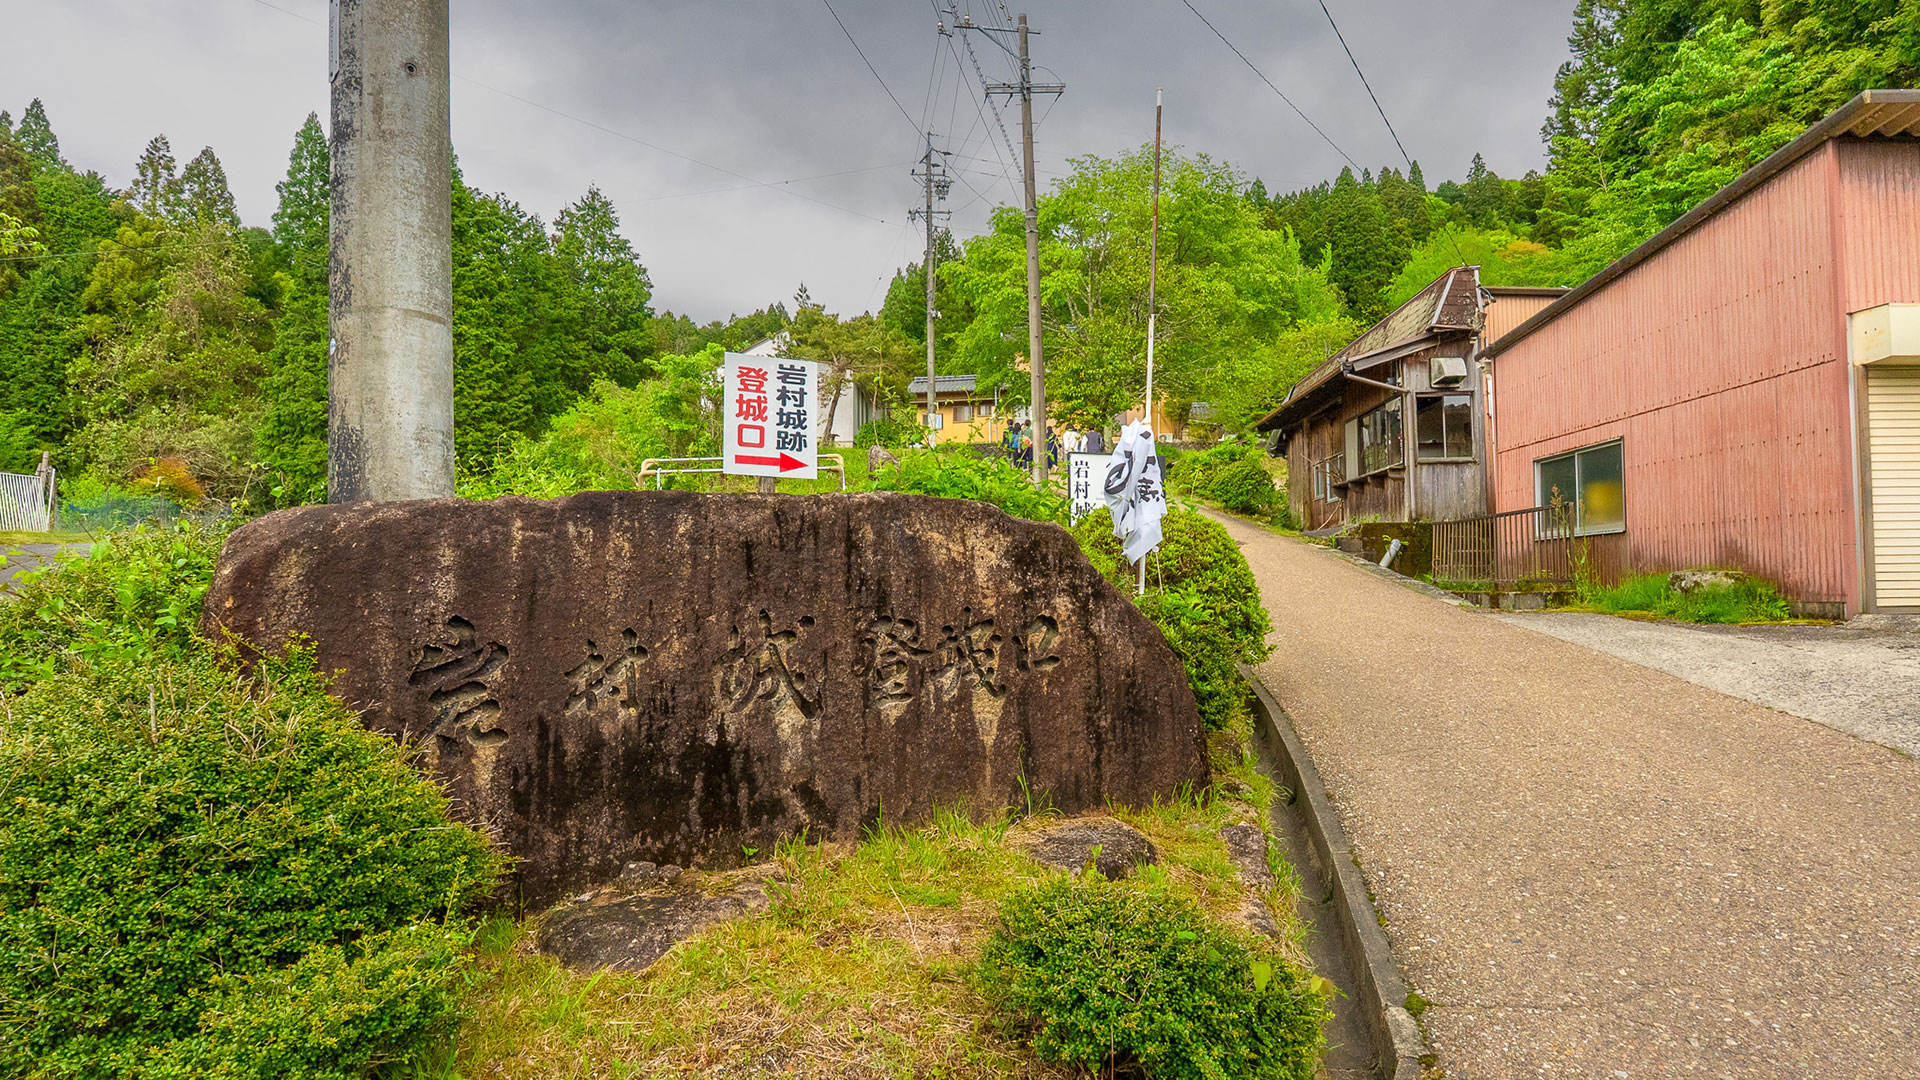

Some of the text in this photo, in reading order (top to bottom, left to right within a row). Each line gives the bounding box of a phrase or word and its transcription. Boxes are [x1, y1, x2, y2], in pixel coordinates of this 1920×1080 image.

[735, 365, 769, 449] 登城口
[776, 363, 808, 452] 岩村城跡
